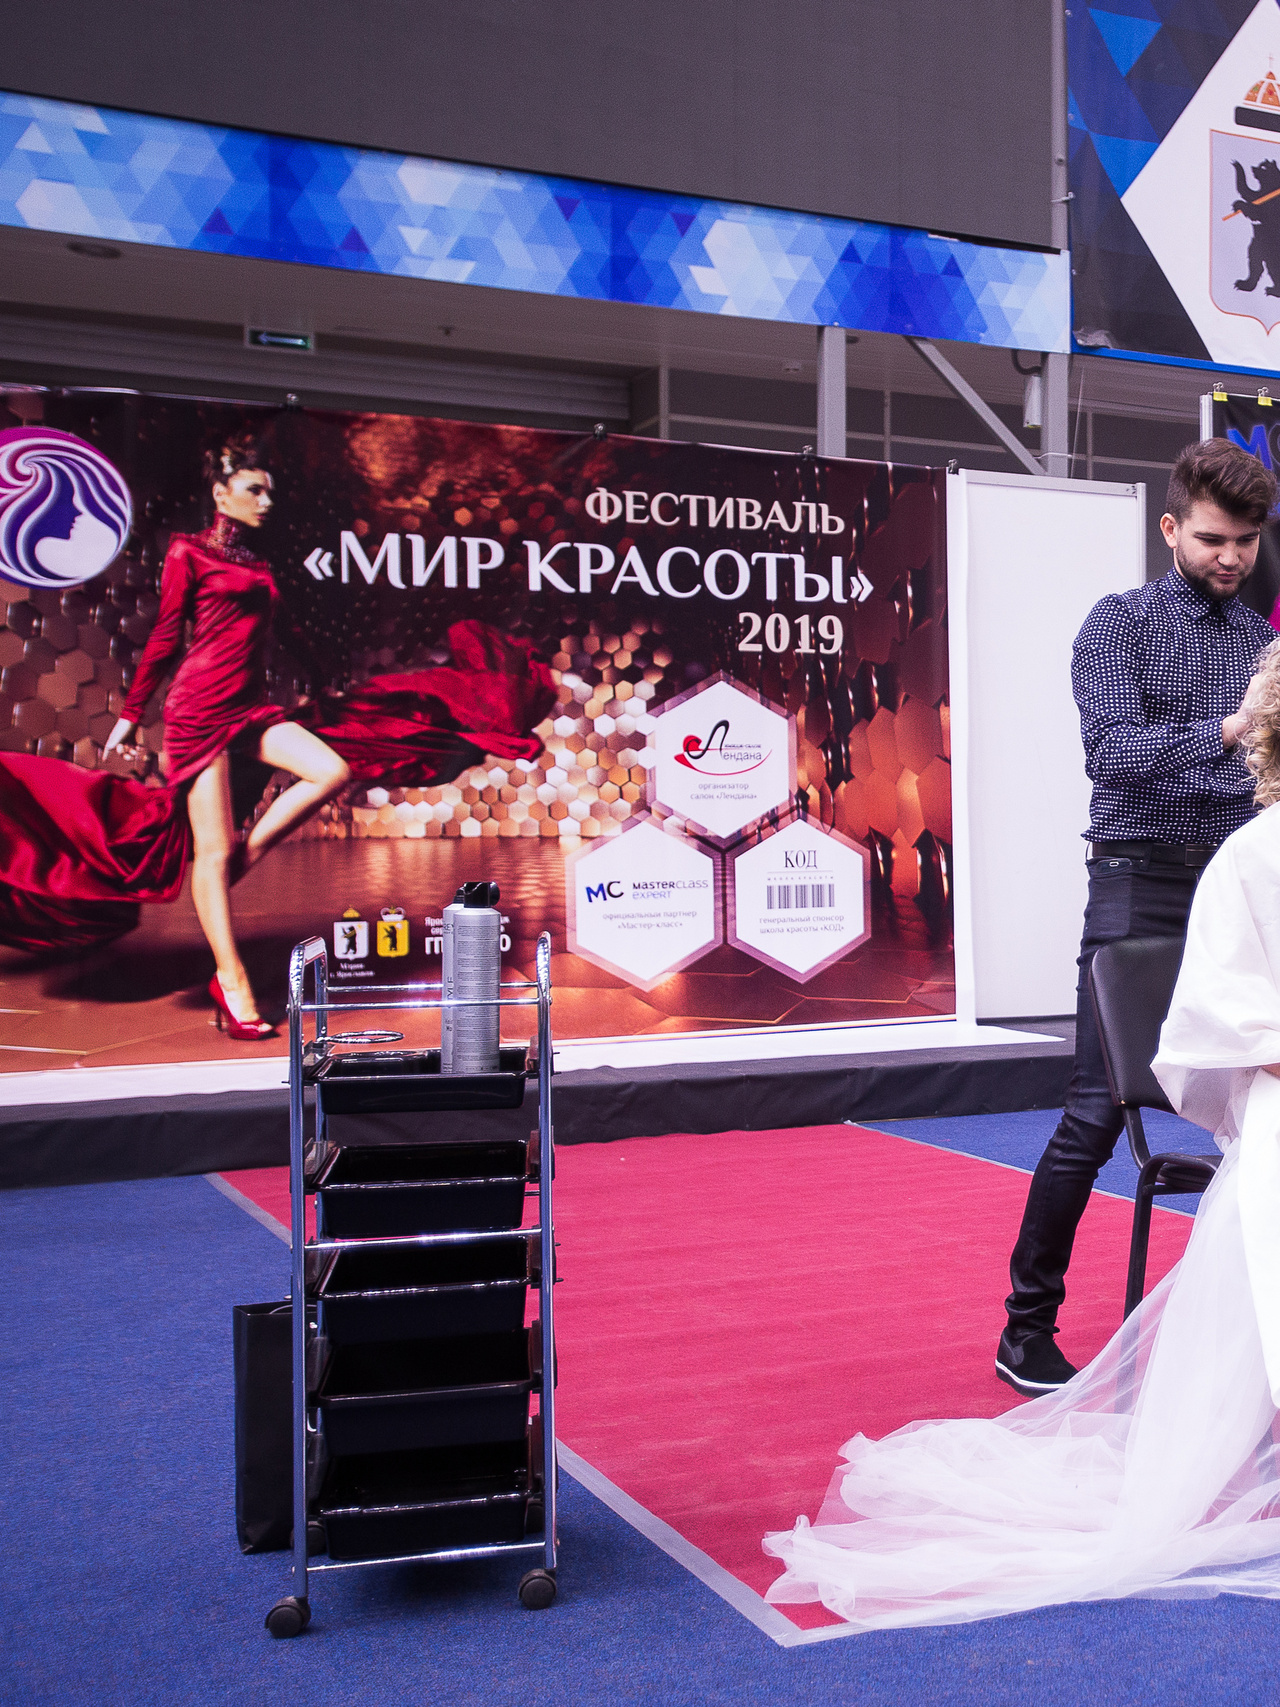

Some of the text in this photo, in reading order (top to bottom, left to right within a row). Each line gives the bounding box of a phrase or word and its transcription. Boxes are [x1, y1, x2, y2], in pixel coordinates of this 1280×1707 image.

[584, 486, 846, 535] ФЕСТИВАЛЬ
[303, 530, 875, 604] «МИР КРАСОТЫ»
[738, 612, 845, 655] 2019
[698, 782, 749, 791] организатор
[784, 850, 818, 869] КОД
[585, 880, 624, 903] MC
[602, 910, 697, 921] официальный партнер
[759, 914, 845, 924] генеральный спонсор
[786, 926, 818, 934] красоты
